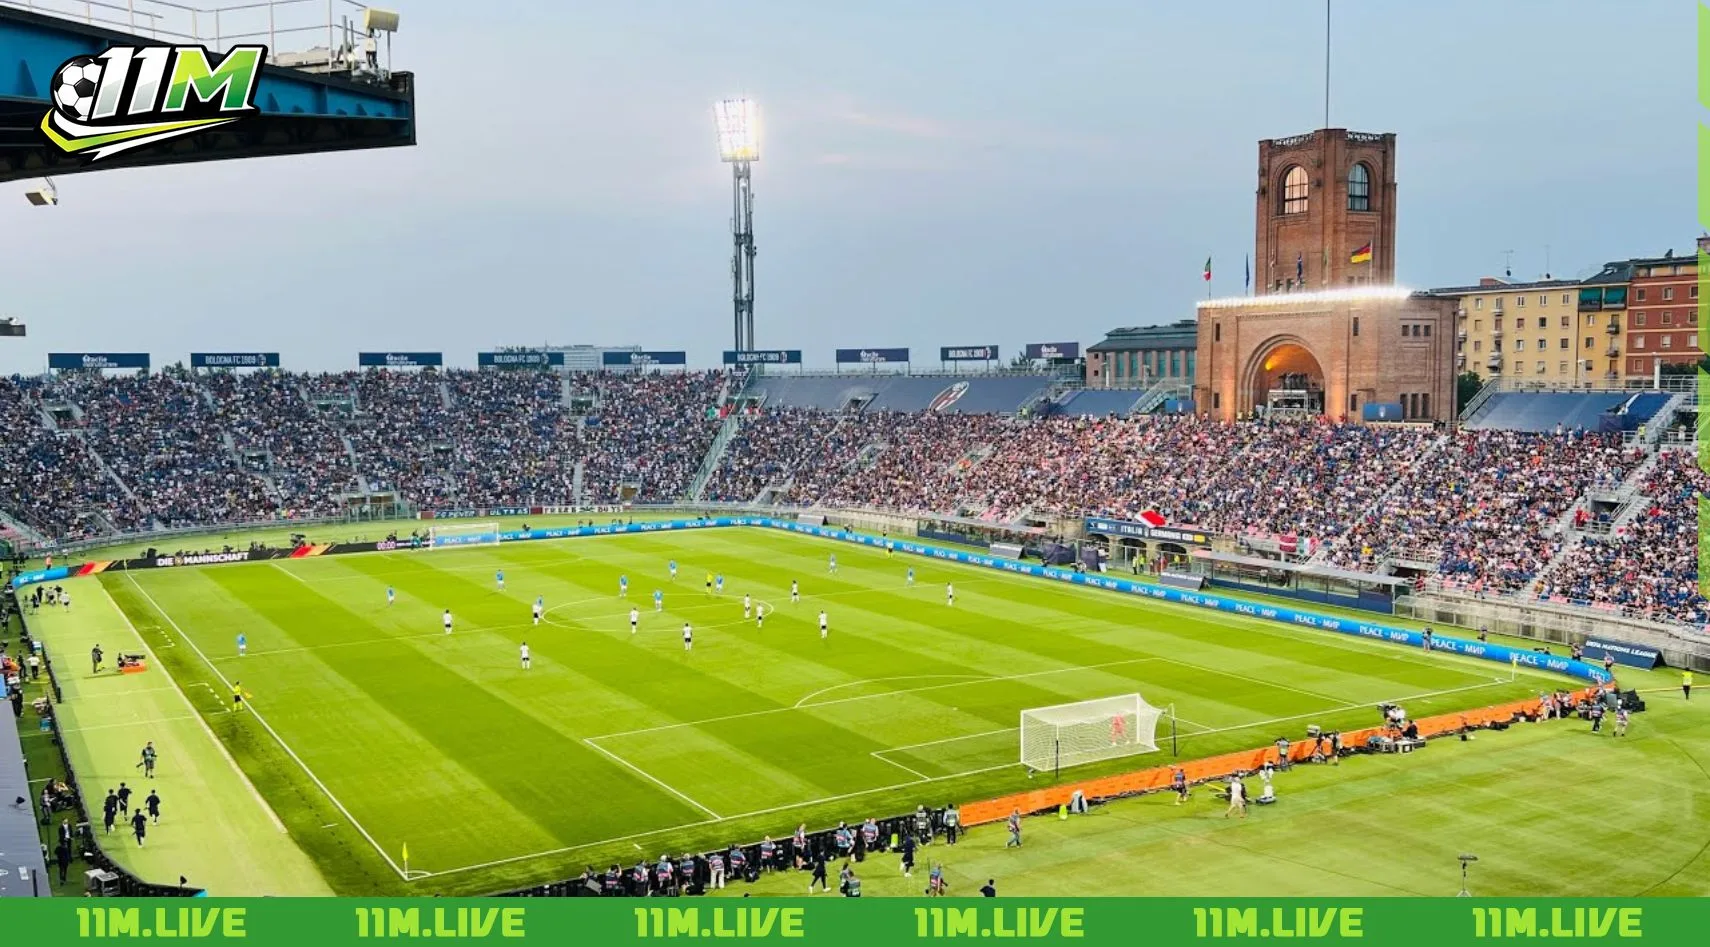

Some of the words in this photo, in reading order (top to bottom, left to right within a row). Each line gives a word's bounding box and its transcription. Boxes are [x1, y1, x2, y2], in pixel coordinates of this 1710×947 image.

[157, 557, 174, 567] DIE
[184, 552, 249, 565] MANNSCHAFT
[1235, 603, 1256, 614] PEACE
[1294, 613, 1316, 625] PEACE
[1360, 625, 1383, 637] PEACE
[1430, 638, 1456, 650] PEACE
[1509, 652, 1538, 665] PEACE
